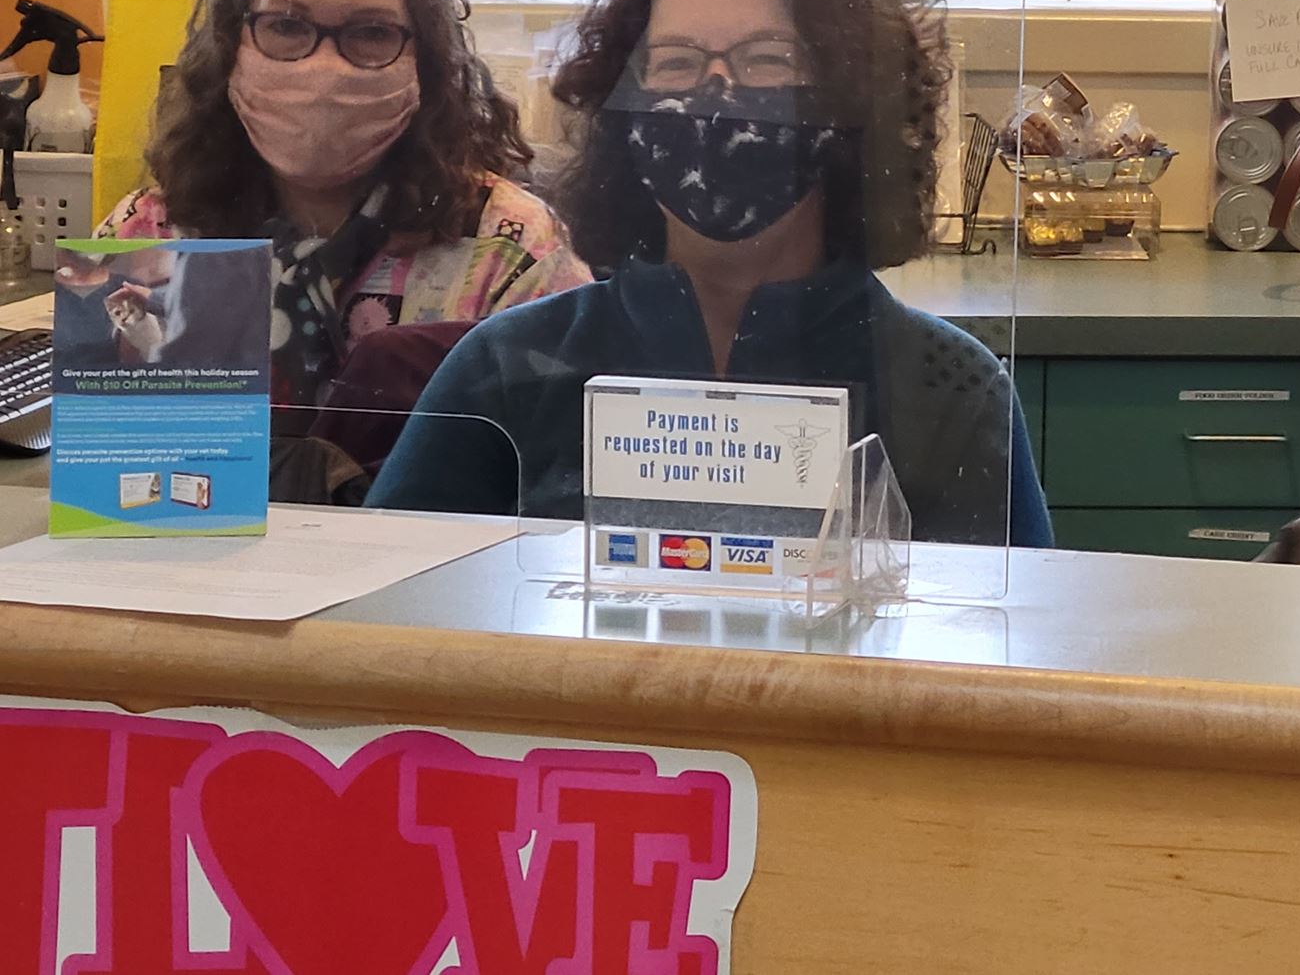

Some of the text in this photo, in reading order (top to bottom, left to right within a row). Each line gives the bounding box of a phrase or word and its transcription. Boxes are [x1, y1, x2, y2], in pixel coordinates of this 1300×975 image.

[647, 409, 739, 433] Payment is
[604, 436, 781, 463] requested on the day
[640, 460, 745, 484] of your visit
[727, 548, 767, 564] VISA
